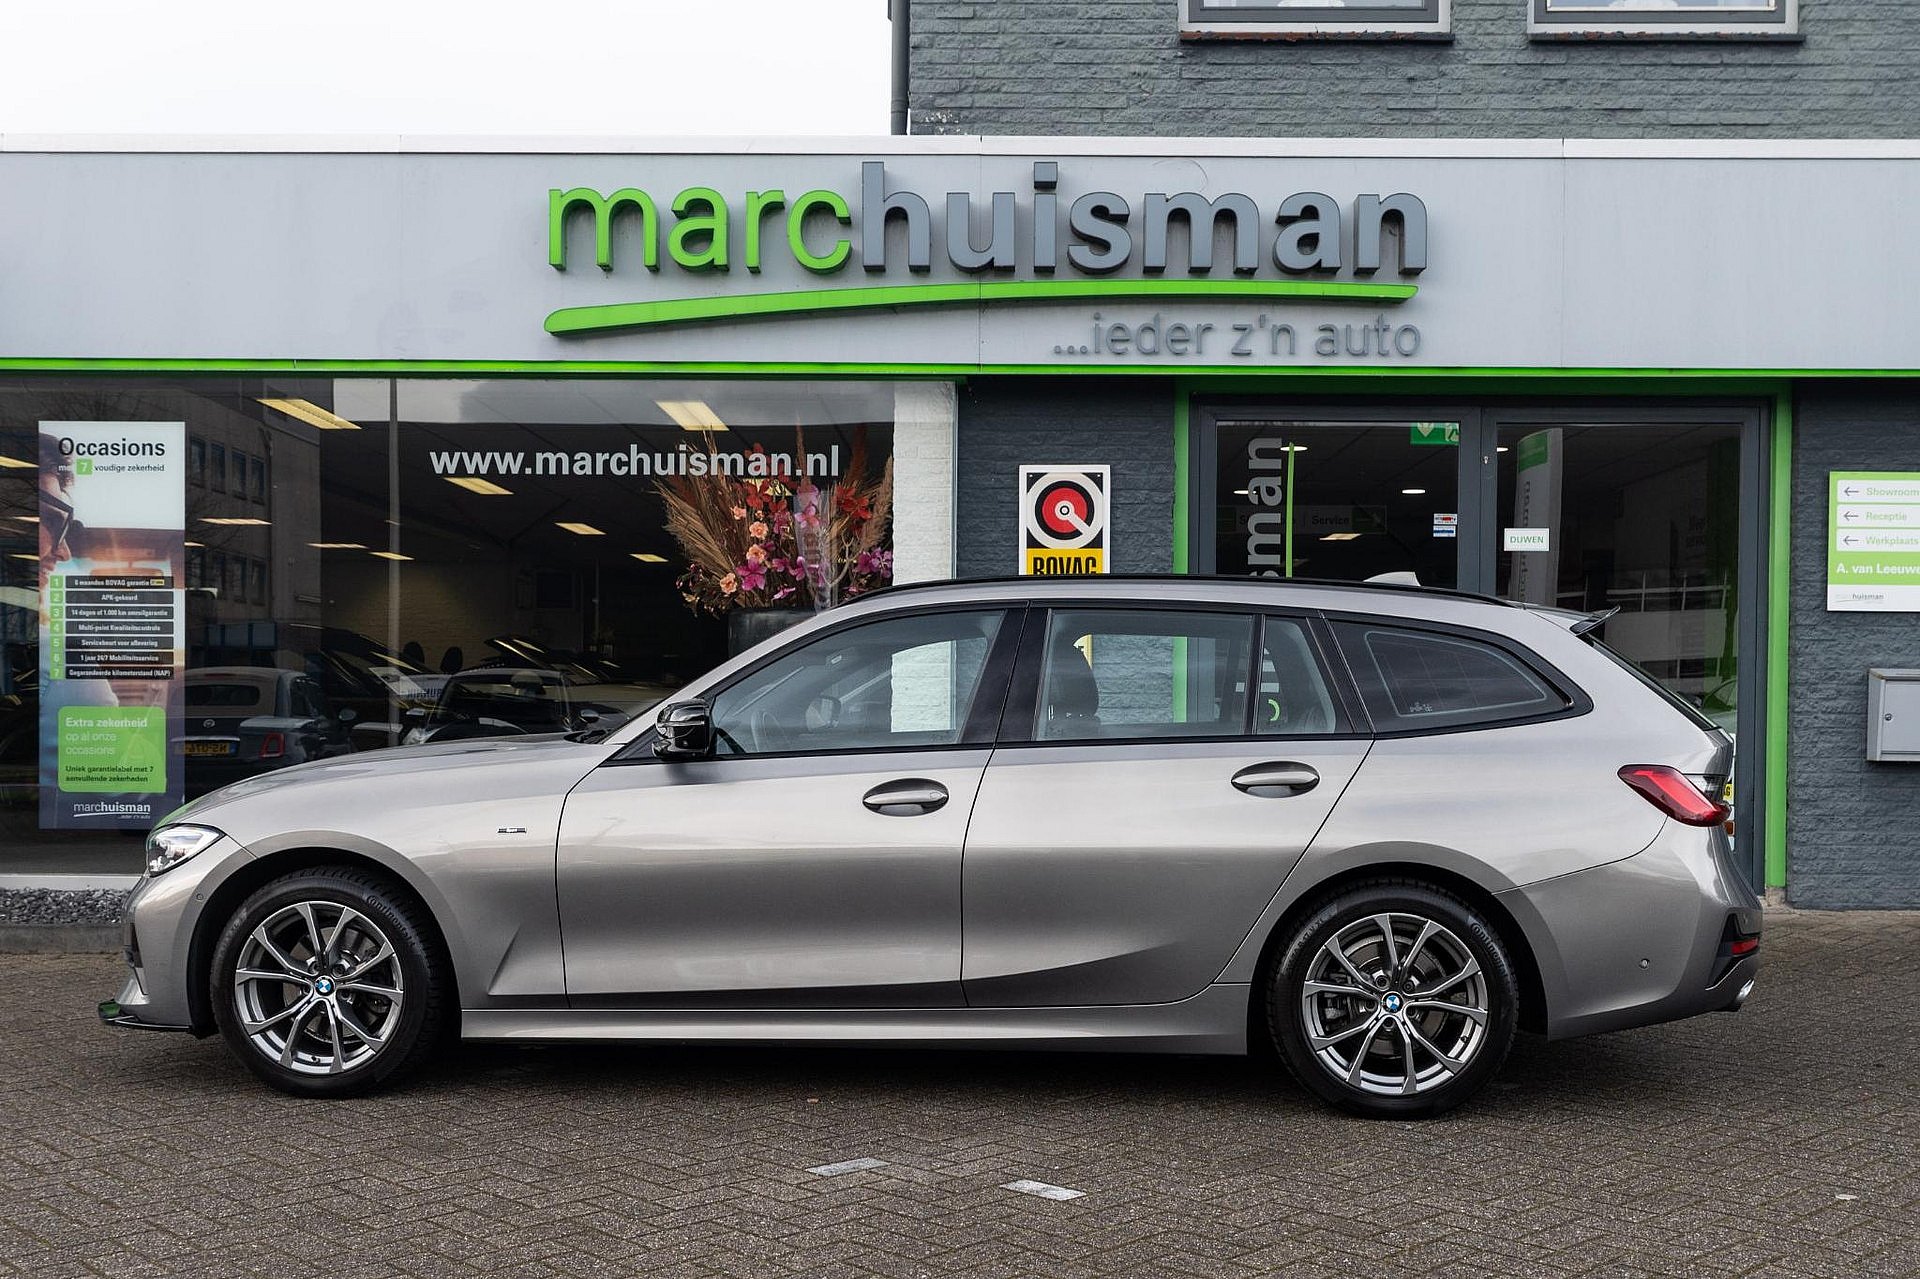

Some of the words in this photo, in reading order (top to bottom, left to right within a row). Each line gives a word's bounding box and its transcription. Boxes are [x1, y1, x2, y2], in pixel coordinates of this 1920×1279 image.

[549, 161, 1428, 275] marchuisman
[1230, 314, 1296, 356] z'n
[1314, 313, 1421, 357] auto
[58, 437, 166, 456] Occasions
[429, 443, 840, 477] www.marchuisman.nl
[81, 462, 88, 473] 7
[94, 464, 126, 473] voudige
[127, 463, 165, 472] zekerheid
[1866, 487, 1919, 497] Showroom
[1865, 511, 1907, 522] Receptie
[1509, 535, 1544, 543] DUWEN
[1865, 536, 1919, 546] Werkplaats
[1836, 563, 1848, 574] A.
[1852, 564, 1873, 574] van
[53, 608, 59, 617] 3
[65, 717, 94, 727] Extra
[96, 716, 148, 727] zekerheid
[66, 733, 79, 742] op
[88, 765, 133, 774] garantielabel
[73, 801, 151, 812] marchuisman
